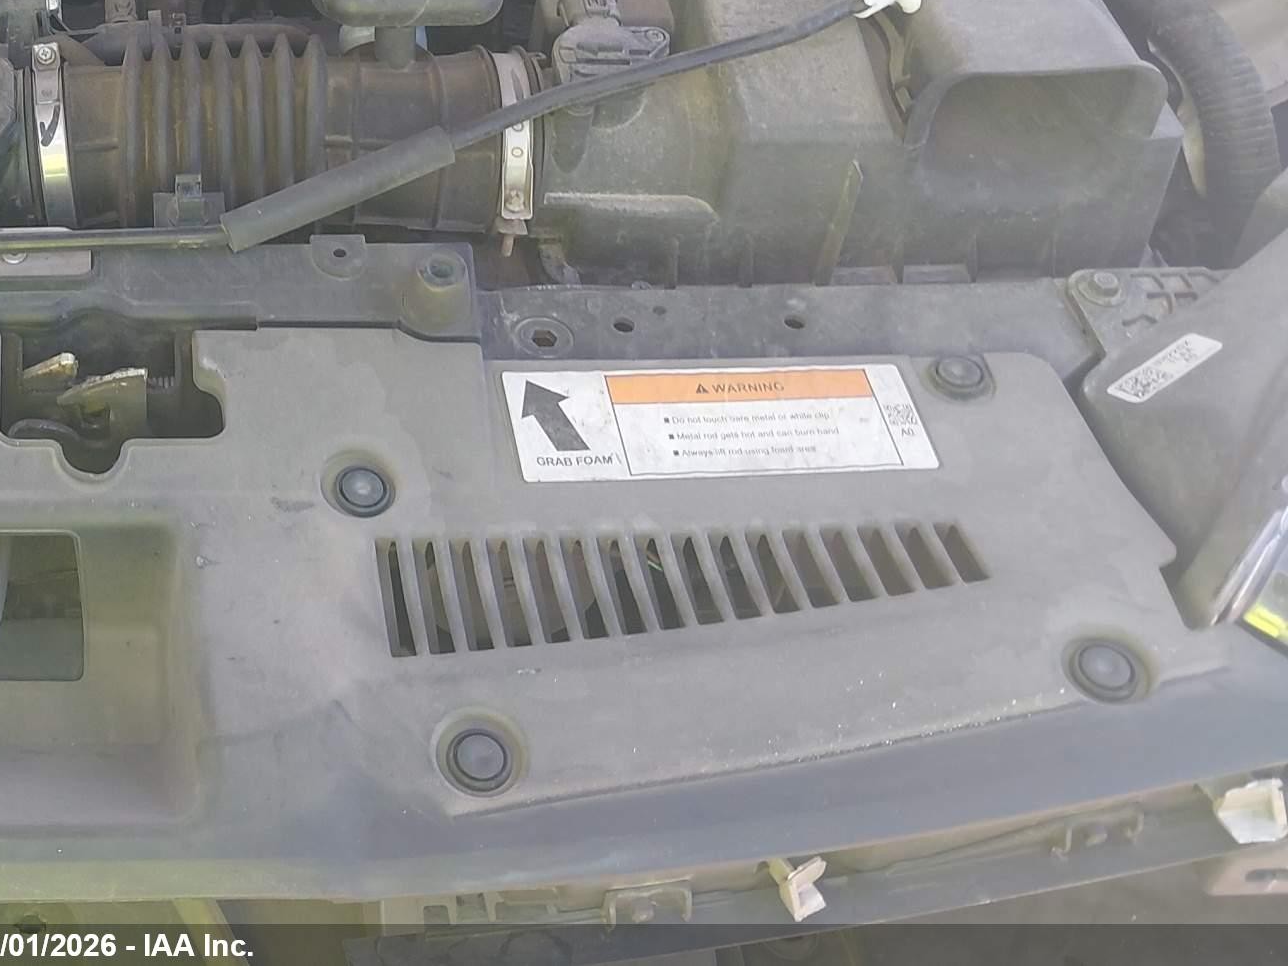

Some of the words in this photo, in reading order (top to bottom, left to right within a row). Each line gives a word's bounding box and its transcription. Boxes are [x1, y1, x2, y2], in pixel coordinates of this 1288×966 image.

[712, 381, 784, 394] WARNING
[682, 449, 713, 458] Always
[536, 456, 573, 467] GRAB
[576, 455, 613, 465] FOAM
